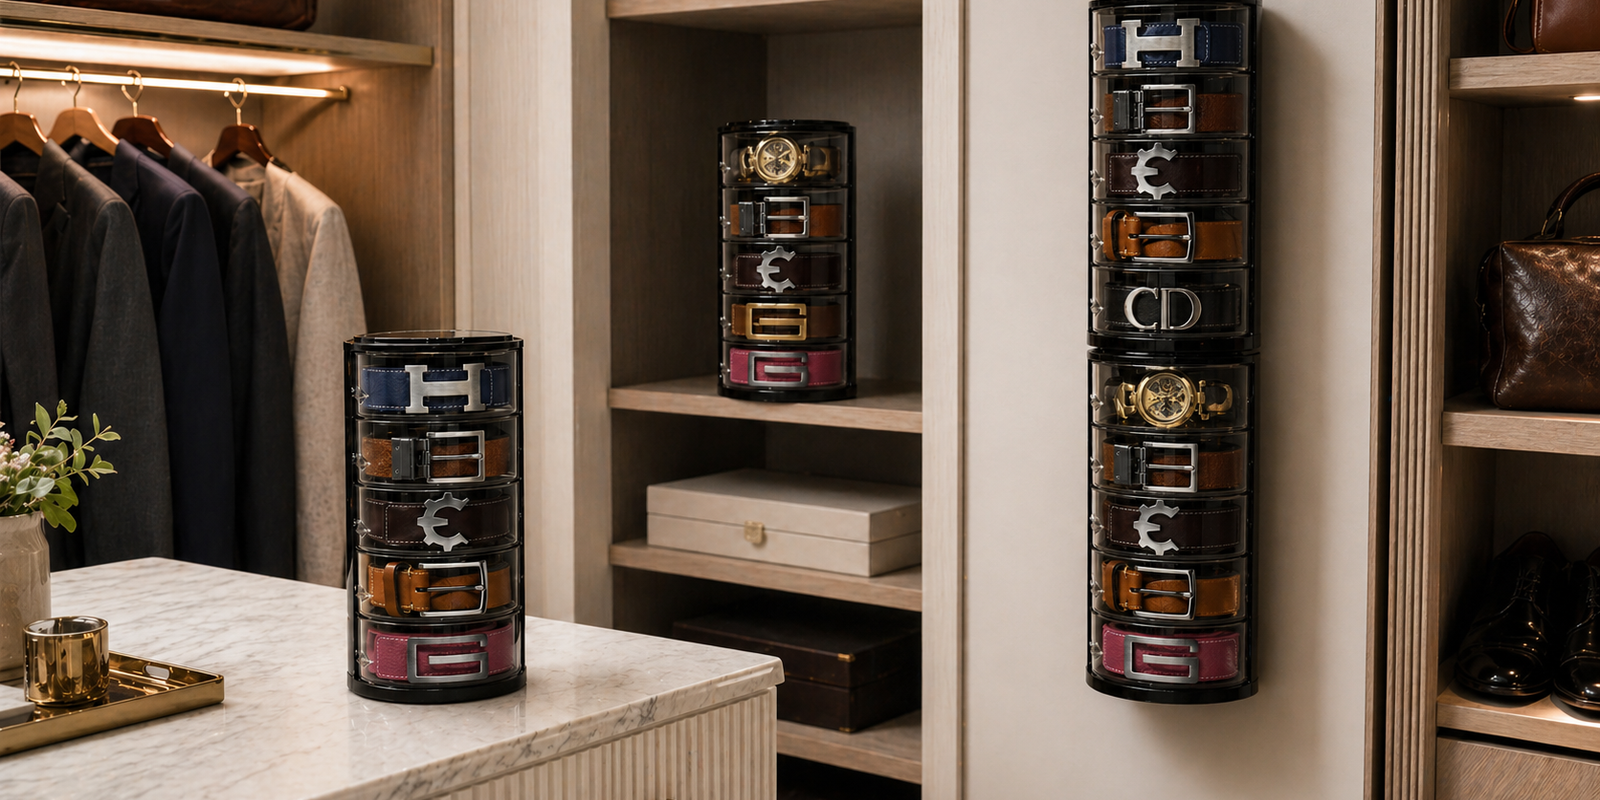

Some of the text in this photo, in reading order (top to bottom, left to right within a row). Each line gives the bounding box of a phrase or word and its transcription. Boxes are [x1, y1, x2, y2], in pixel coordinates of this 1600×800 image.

[1124, 286, 1202, 332] CD
[407, 633, 489, 684] G
[1123, 634, 1199, 684] G
